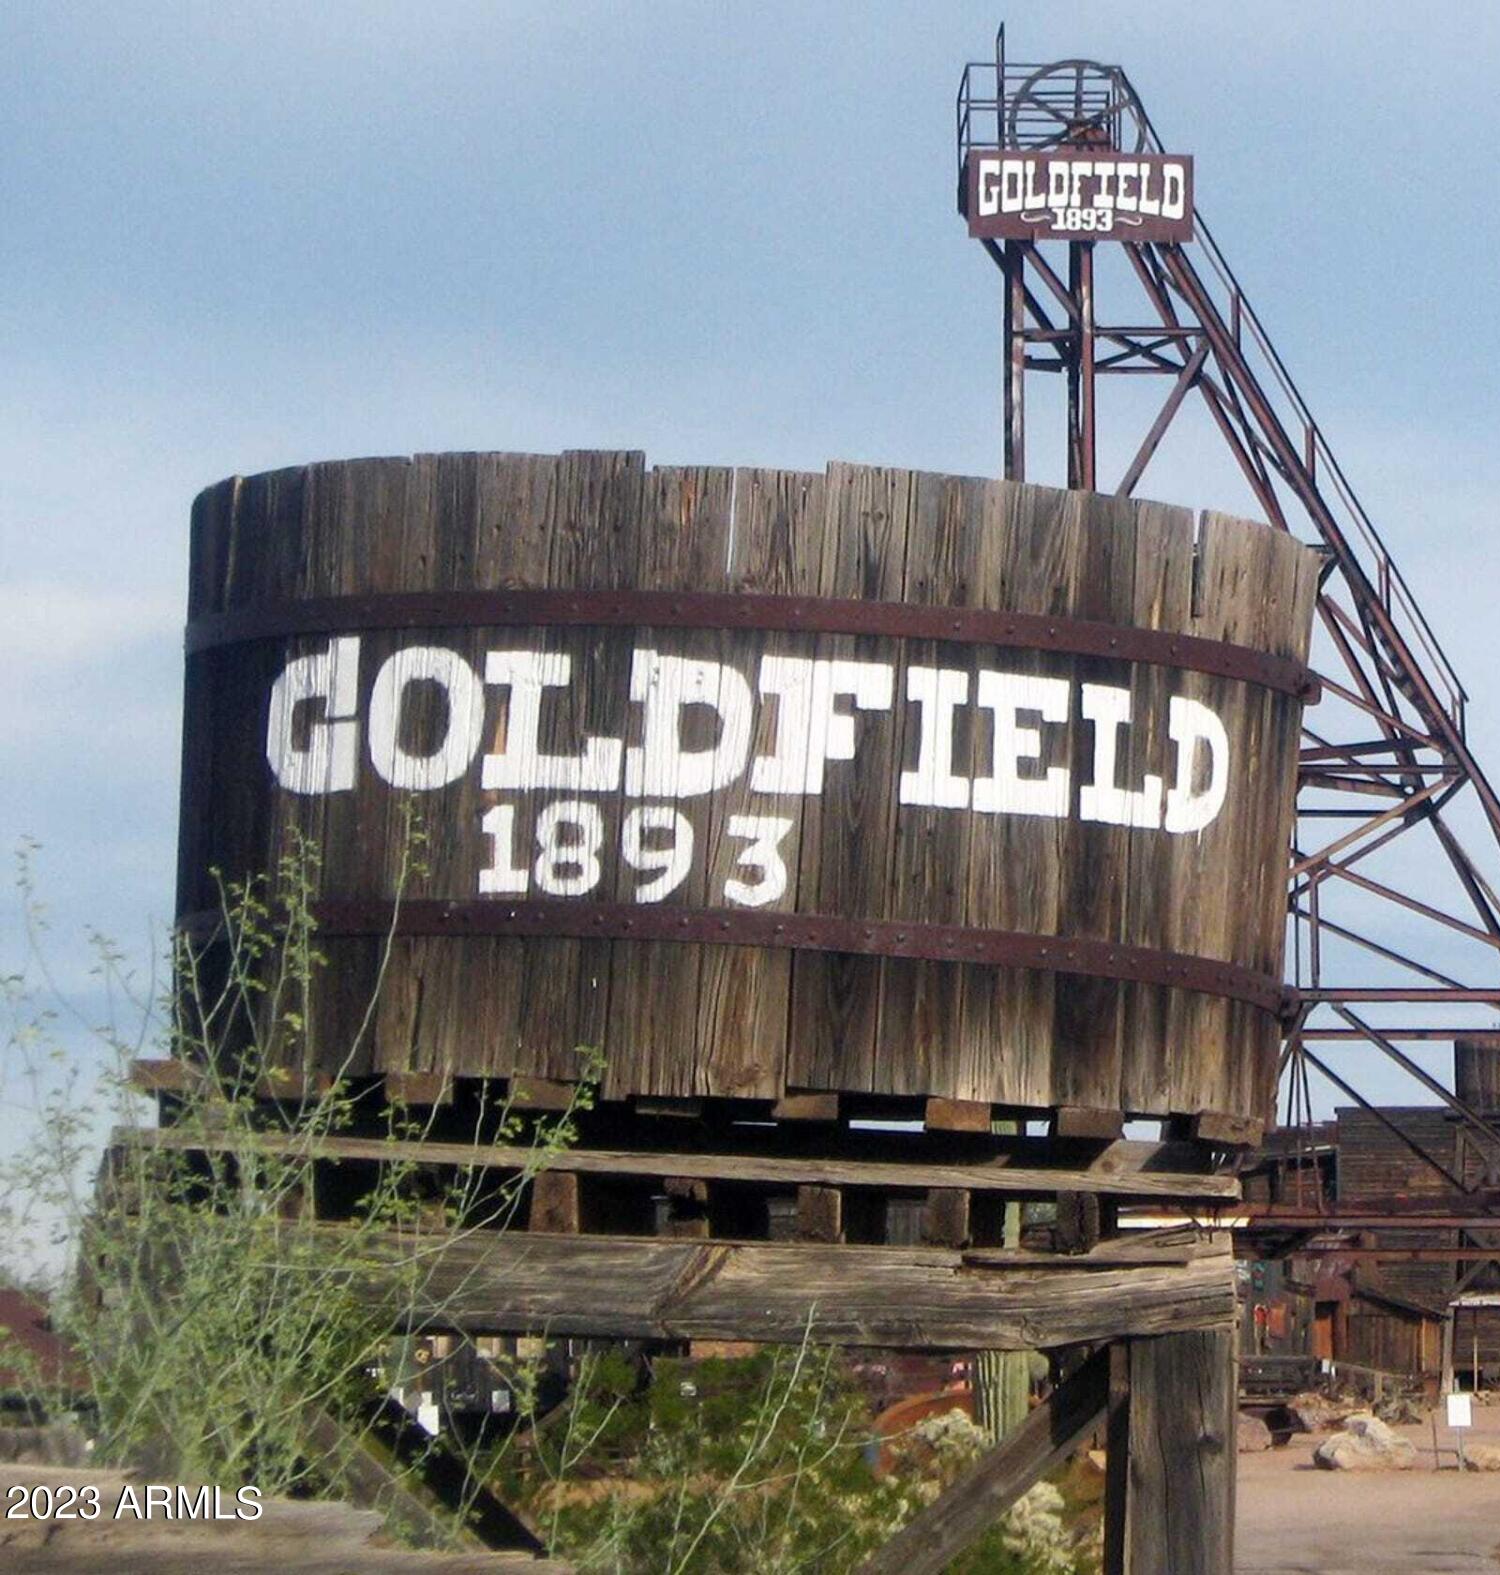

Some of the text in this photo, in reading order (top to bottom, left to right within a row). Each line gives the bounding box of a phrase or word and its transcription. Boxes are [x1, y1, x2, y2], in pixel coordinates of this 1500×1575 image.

[978, 159, 1185, 220] GOLDFIELD
[1051, 206, 1113, 231] 1893
[266, 636, 1229, 835] GOLDFIELD
[478, 800, 794, 907] 1893
